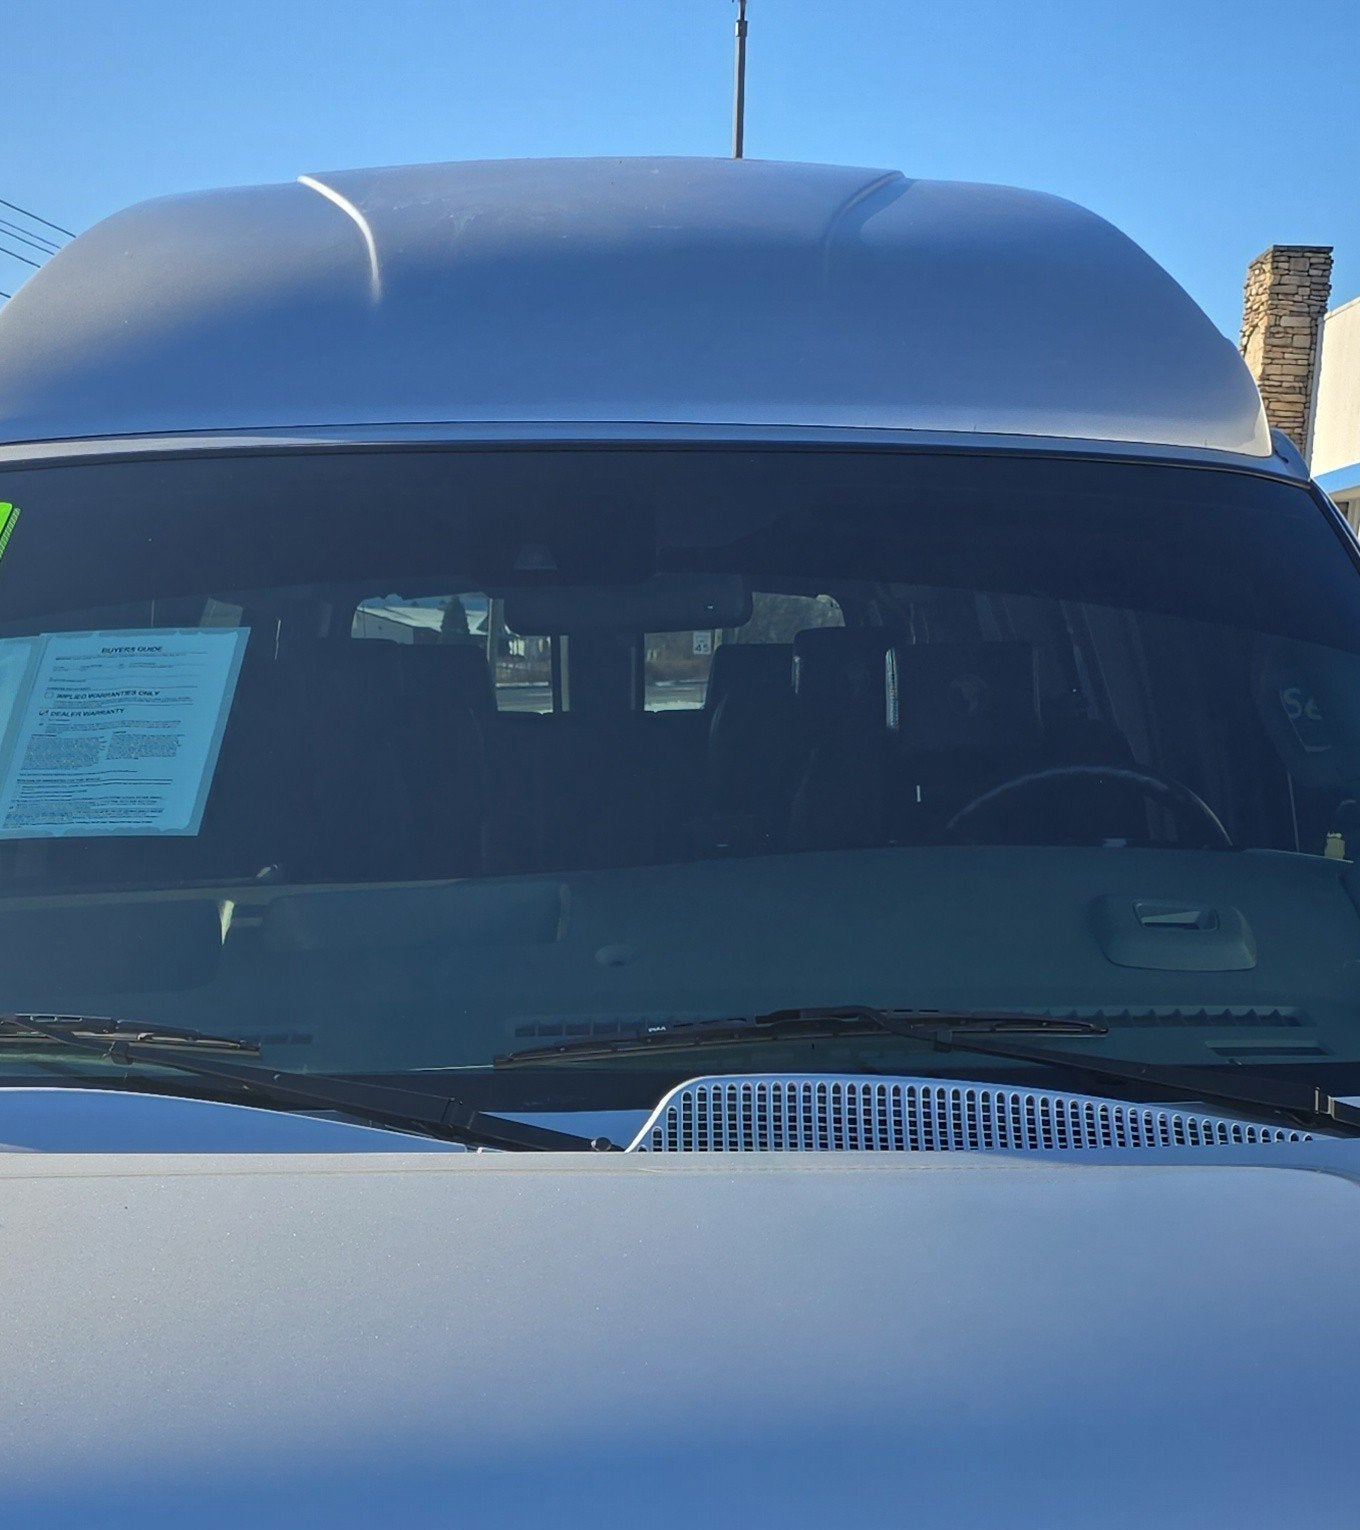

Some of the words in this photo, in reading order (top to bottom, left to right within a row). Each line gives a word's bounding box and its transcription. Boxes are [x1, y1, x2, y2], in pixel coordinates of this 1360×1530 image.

[101, 646, 136, 654] BUYERS
[56, 692, 88, 700] IMPLIED
[88, 690, 137, 699] WARRANTIES
[49, 710, 83, 718] DEALER
[83, 708, 126, 717] WARRANTY
